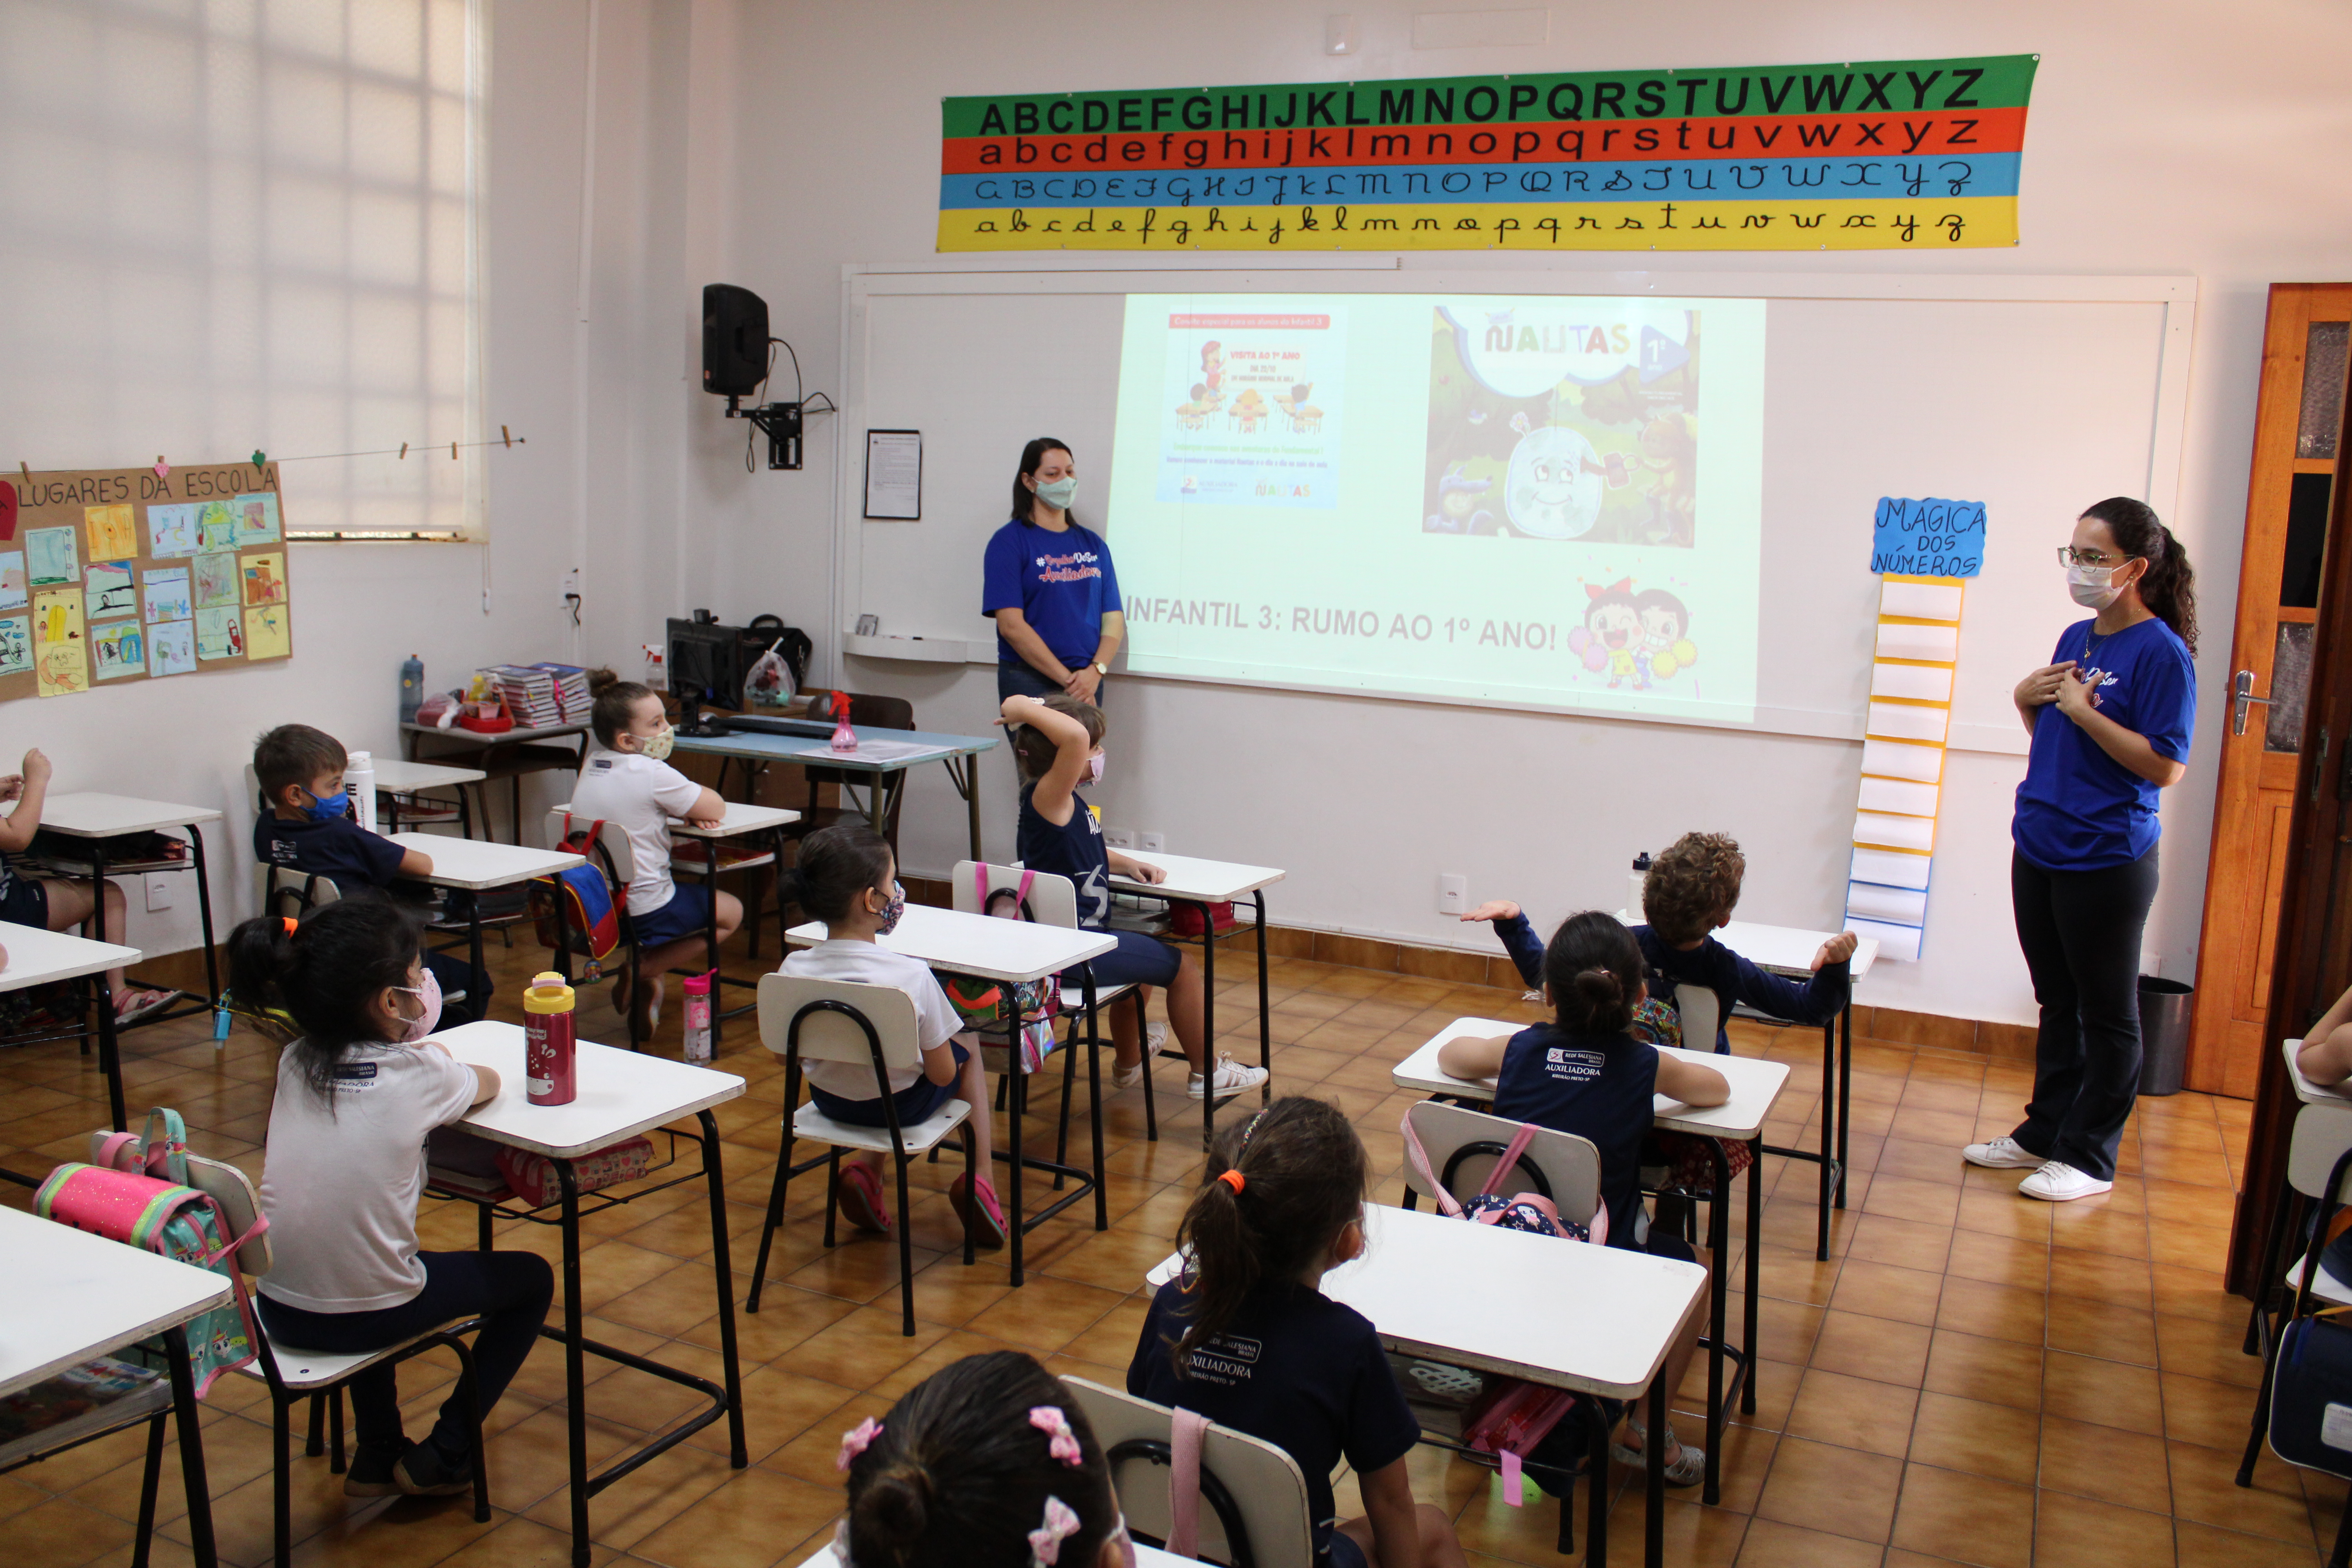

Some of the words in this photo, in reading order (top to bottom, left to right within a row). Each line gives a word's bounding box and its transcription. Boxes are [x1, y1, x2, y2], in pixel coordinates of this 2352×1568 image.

[1230, 351, 1256, 359] VISITA
[1282, 352, 1301, 360] ANO
[18, 476, 129, 508] LUGARES
[140, 476, 172, 499] DA
[186, 468, 279, 497] ESCOLA
[1877, 497, 1985, 534] MÁGICA
[1917, 535, 1956, 553] DOS
[1871, 544, 1977, 576] NÚMEROS
[1125, 595, 1249, 628] INFANTIL
[1258, 605, 1281, 630] 3:
[1292, 607, 1379, 637] RUMO
[1388, 613, 1432, 641] AO
[1445, 617, 1470, 642] 1º
[1478, 620, 1556, 650] ANO!
[1545, 1064, 1601, 1076] AUXILIADORA
[1223, 1342, 1256, 1353] ALESIANA
[1238, 1350, 1254, 1358] BRASIL
[1181, 1354, 1251, 1379] XILIADORA
